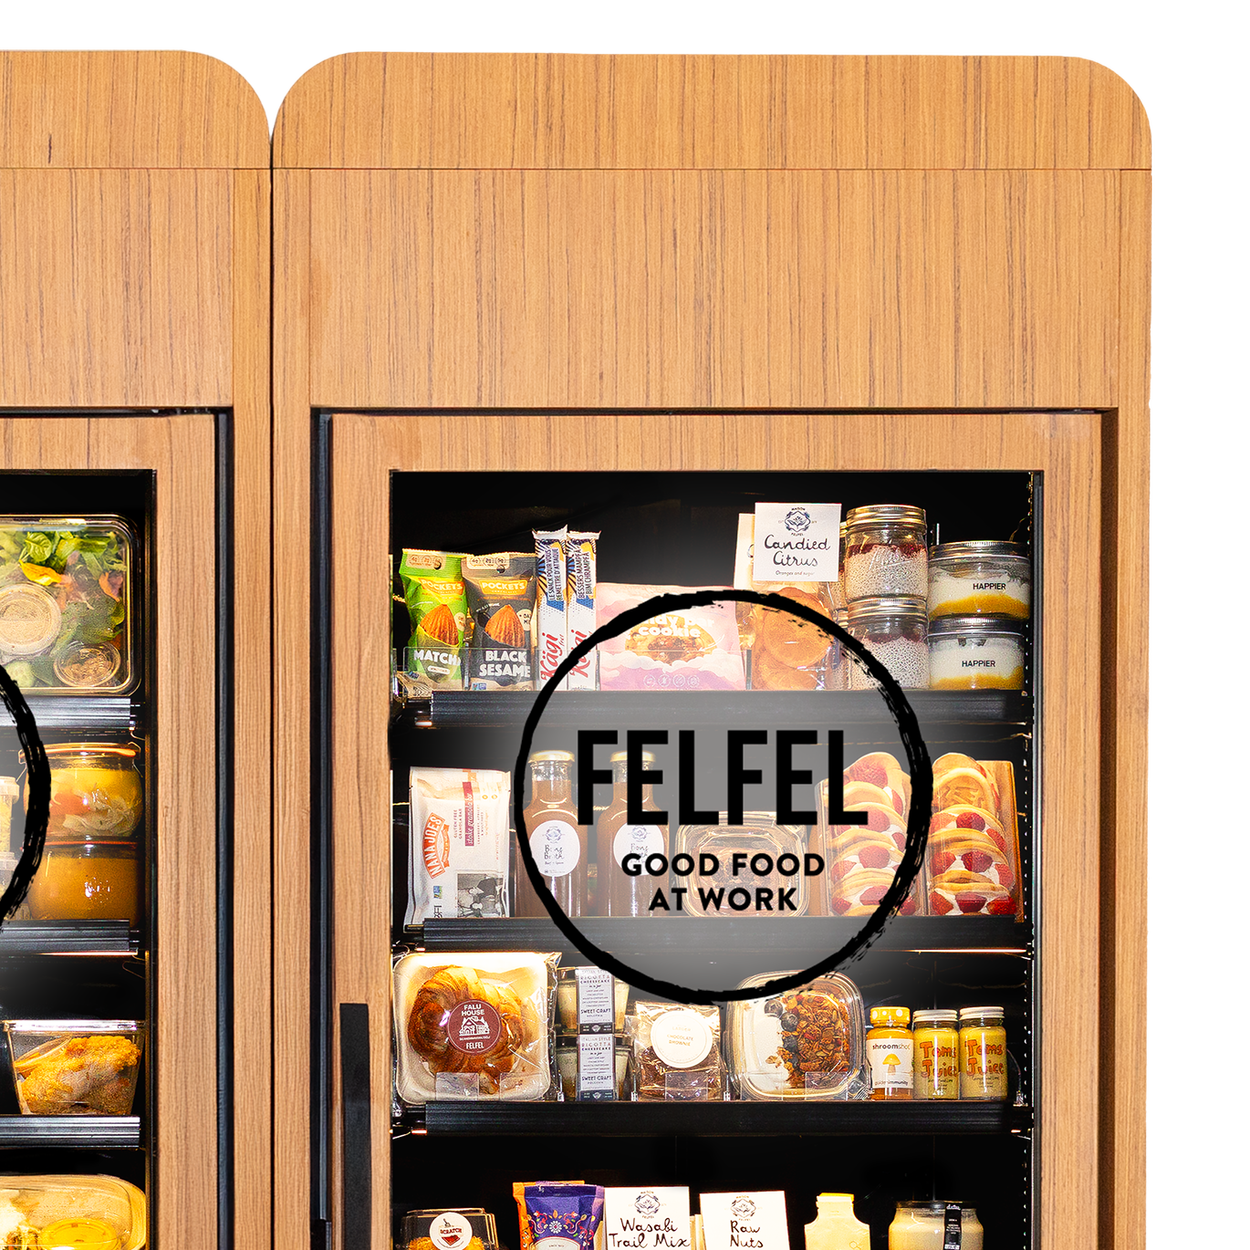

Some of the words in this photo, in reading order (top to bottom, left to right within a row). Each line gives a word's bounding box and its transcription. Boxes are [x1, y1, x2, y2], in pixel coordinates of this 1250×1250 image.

[764, 534, 831, 550] Candied
[773, 550, 818, 566] Citrus
[421, 579, 464, 590] POCKETS
[482, 581, 526, 590] POCKETS
[972, 582, 1007, 590] HAPPIER
[638, 623, 701, 637] cookie
[485, 650, 527, 663] BLACK
[961, 659, 996, 668] HAPPIER
[479, 663, 531, 678] SESAME
[577, 730, 868, 826] FELFEL
[424, 816, 442, 844] JOES
[424, 844, 442, 876] NANA
[621, 853, 720, 877] GOOD
[732, 853, 825, 877] FOOD
[648, 887, 687, 911] AT
[698, 887, 797, 911] WORK
[466, 1042, 484, 1050] FELFEL
[919, 1041, 956, 1058] Toms
[965, 1040, 1003, 1056] Toms
[967, 1058, 1004, 1076] Juice
[620, 1217, 678, 1233] Wasabi
[730, 1220, 761, 1234] Raw
[608, 1232, 648, 1248] Trail
[653, 1233, 691, 1248] Mix
[730, 1234, 764, 1248] Nuts
